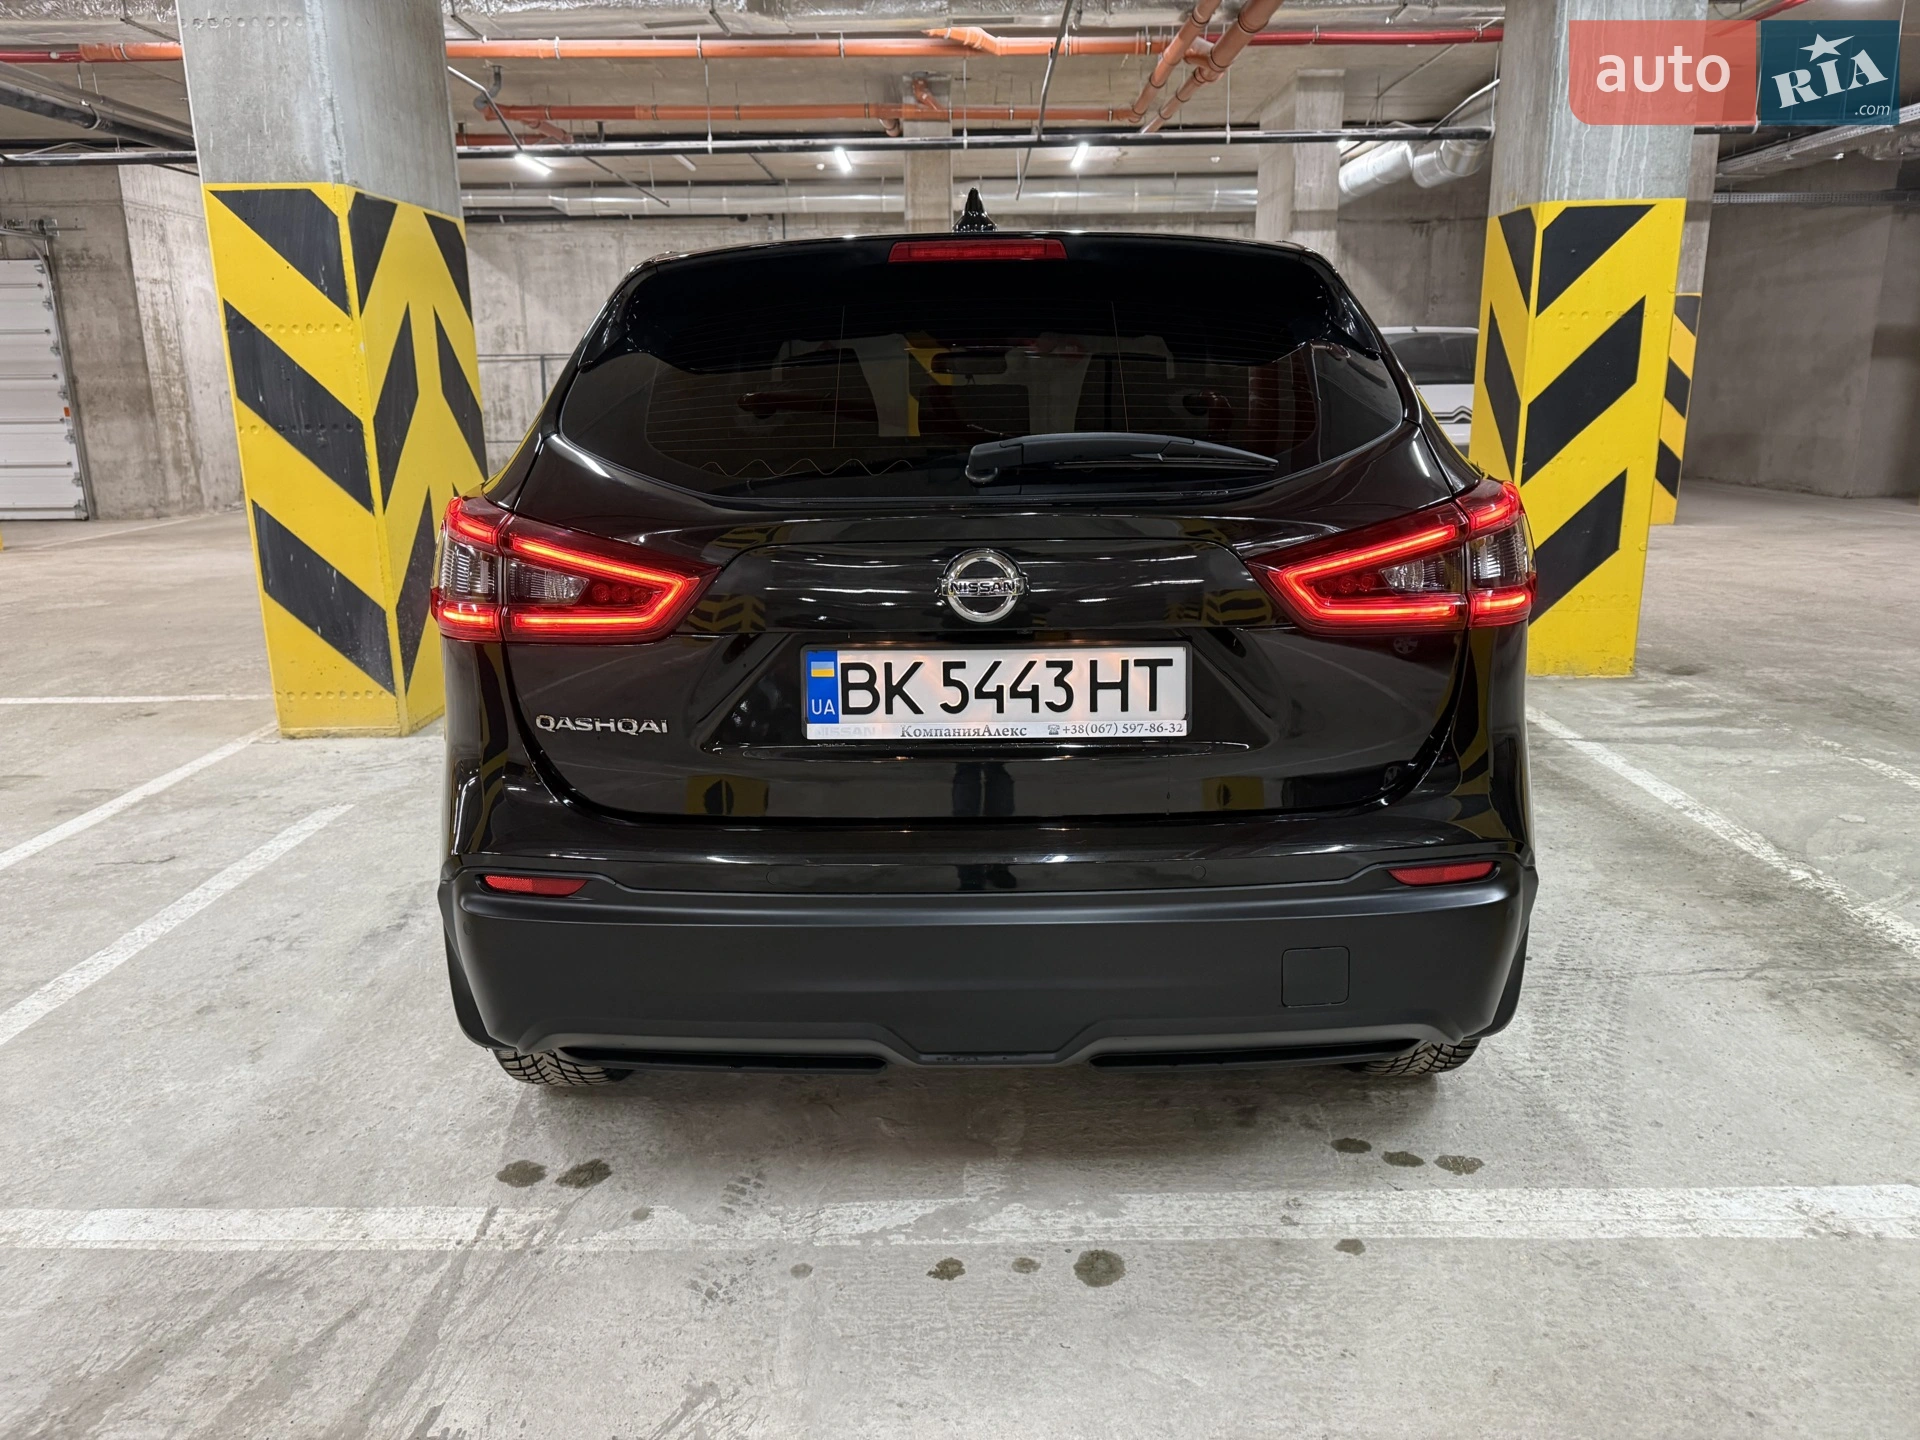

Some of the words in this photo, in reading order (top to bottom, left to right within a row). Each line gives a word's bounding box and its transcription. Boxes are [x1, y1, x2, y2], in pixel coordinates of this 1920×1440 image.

[950, 582, 1015, 593] NISSAN
[840, 660, 924, 716] BK
[939, 659, 1074, 714] 5443
[1090, 659, 1174, 713] HT
[811, 699, 836, 716] UA
[535, 714, 668, 736] QASHQAI
[1062, 723, 1119, 736] +38(067)
[1122, 722, 1184, 734] 597-86-32
